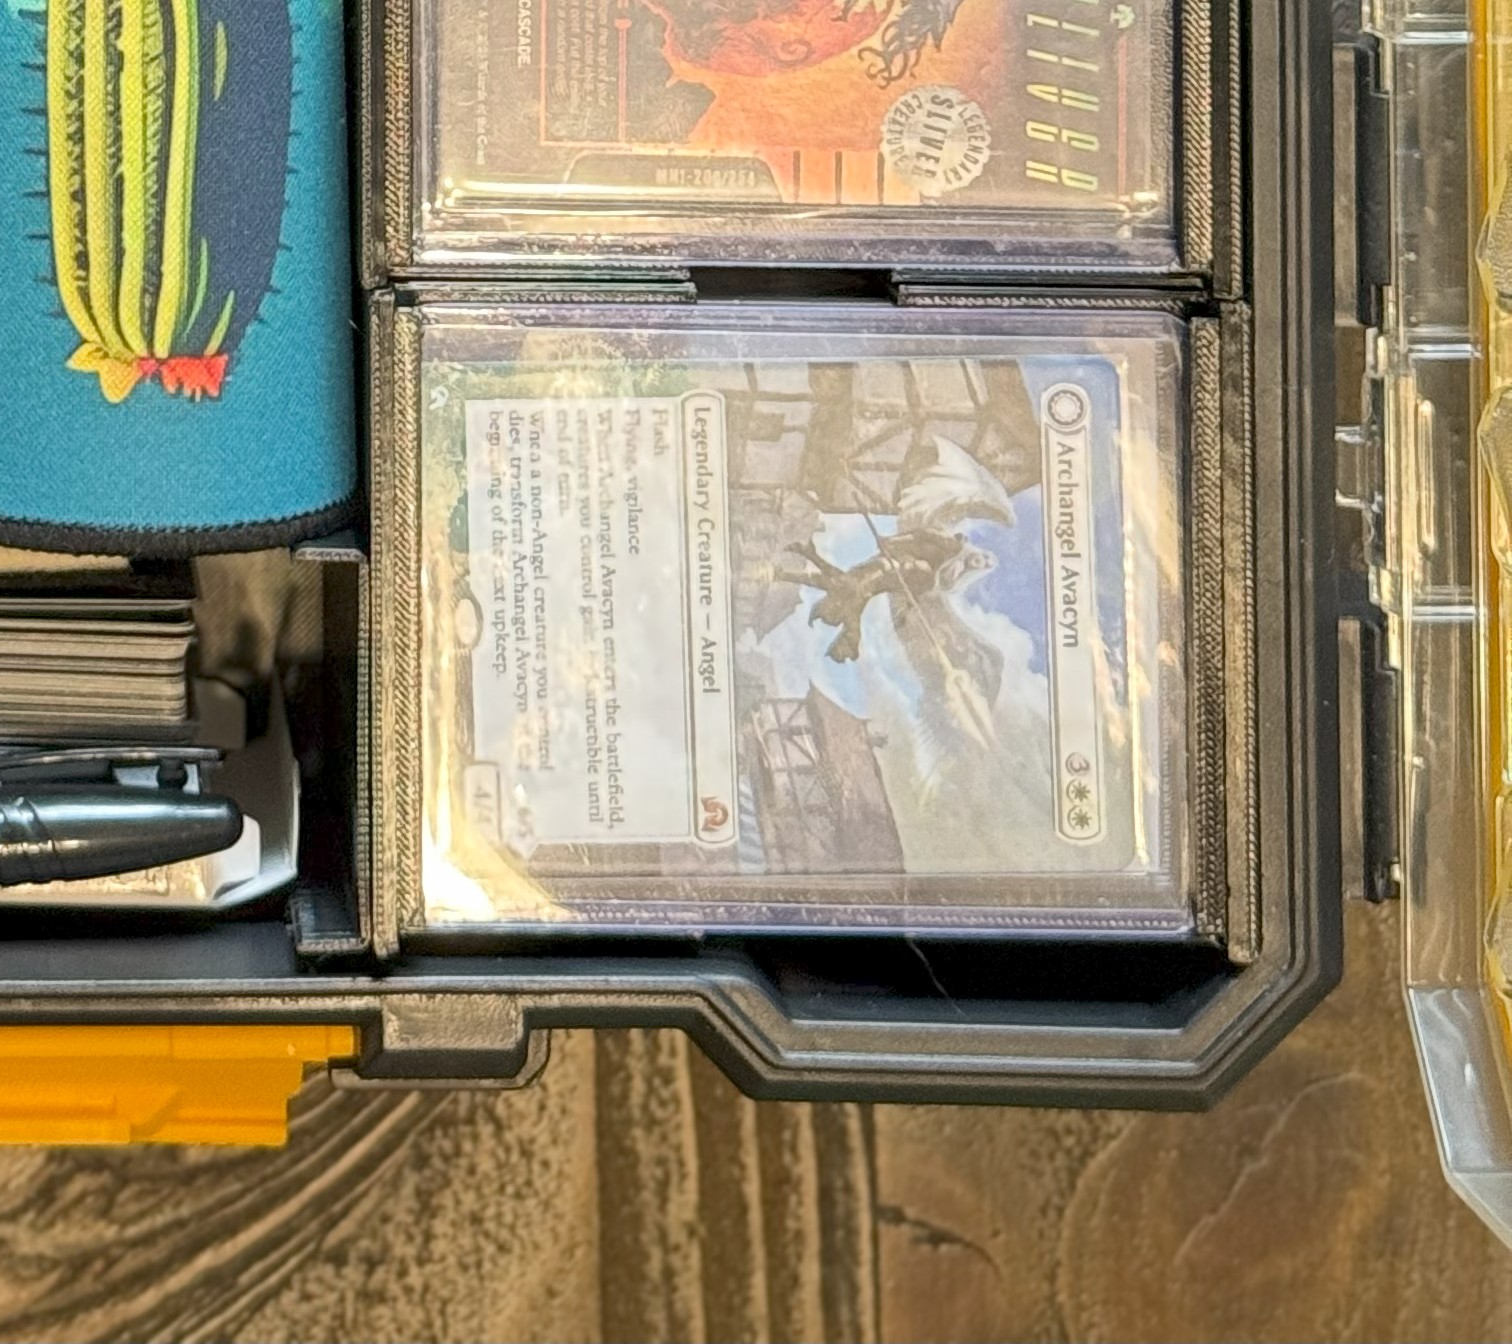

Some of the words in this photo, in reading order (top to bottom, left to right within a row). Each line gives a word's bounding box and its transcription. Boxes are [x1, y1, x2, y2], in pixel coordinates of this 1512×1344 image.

[911, 94, 954, 178] SLIVER
[942, 107, 986, 186] LEGENDARY
[652, 408, 668, 456] Flash
[692, 407, 714, 511] Legendary
[623, 476, 642, 555] vigilance
[1054, 441, 1081, 558] Archangel
[599, 565, 616, 630] Avacyn
[697, 518, 715, 606] Creature
[490, 610, 505, 677] upkeep.
[1061, 565, 1080, 648] Avacyn
[699, 637, 720, 694] Angel
[605, 699, 621, 726] the
